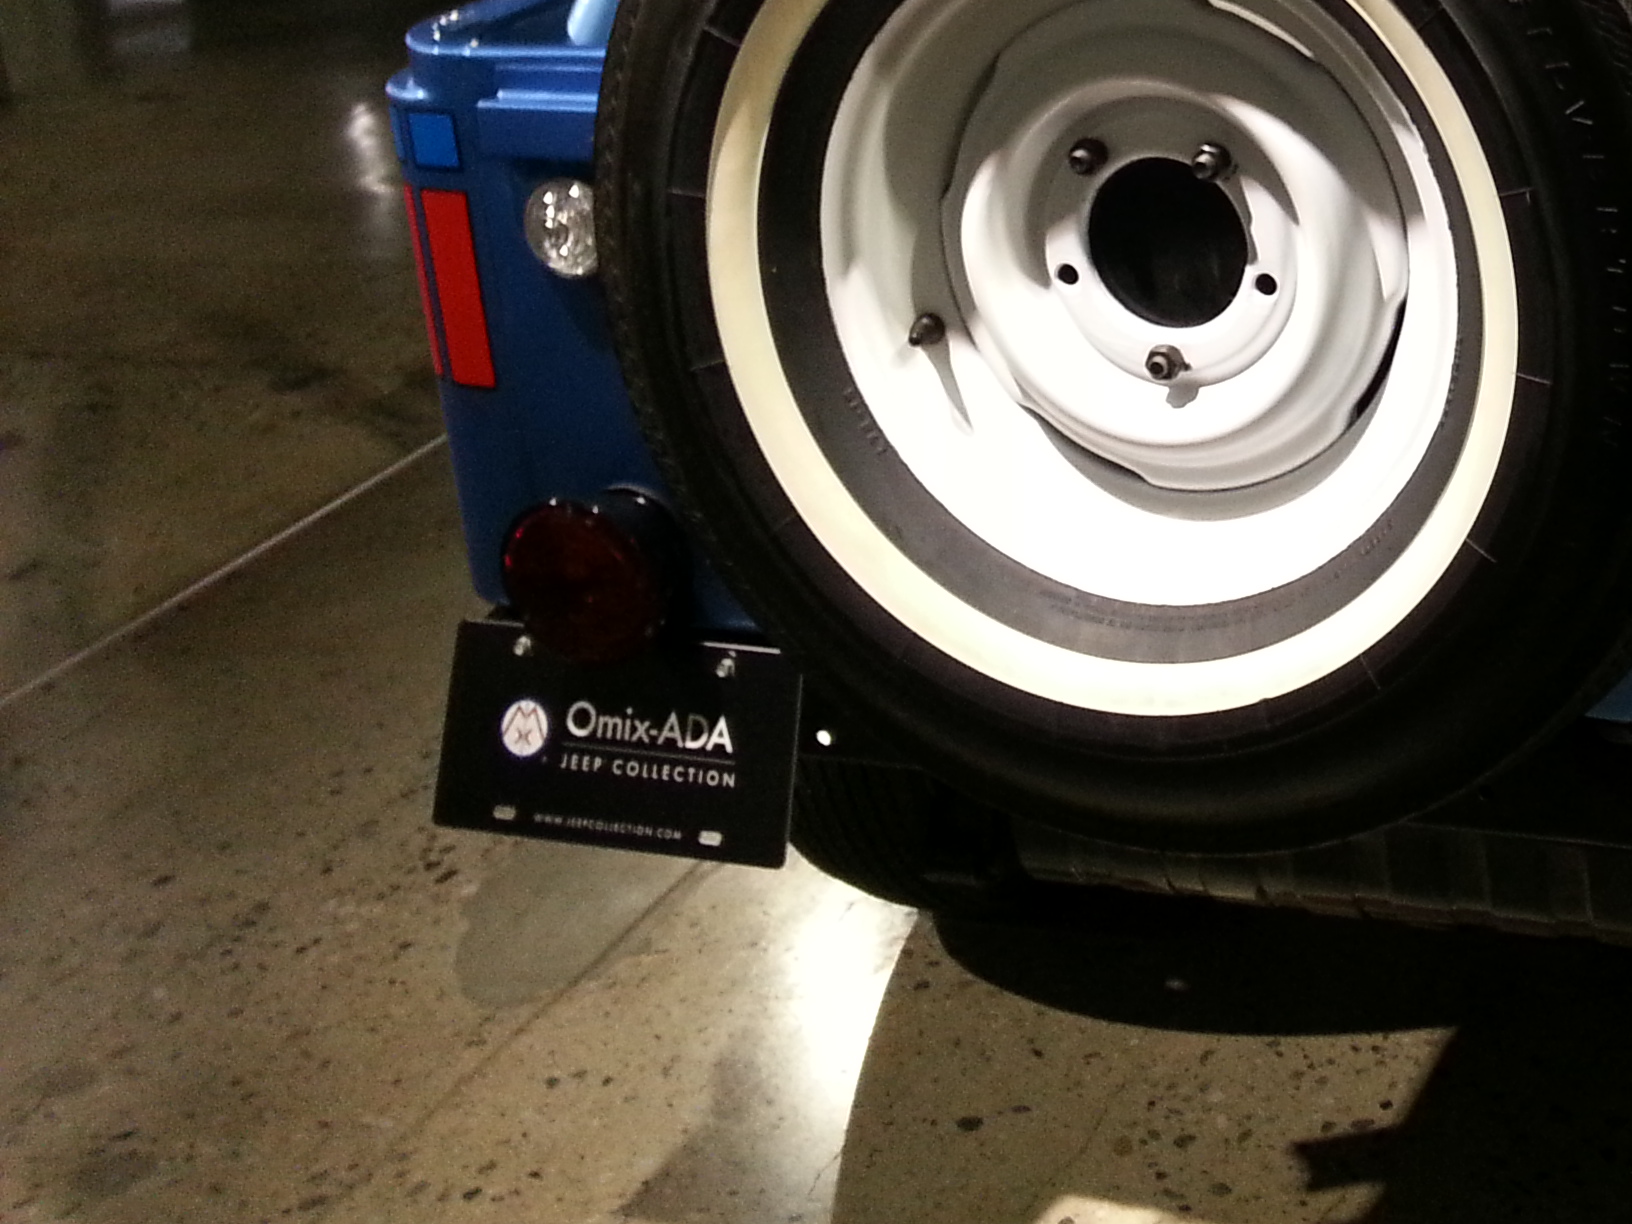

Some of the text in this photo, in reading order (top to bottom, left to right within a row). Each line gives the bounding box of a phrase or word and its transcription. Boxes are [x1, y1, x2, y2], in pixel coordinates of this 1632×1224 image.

[566, 700, 733, 754] Omix-ADA
[560, 753, 736, 788] JEEP COLLECTION
